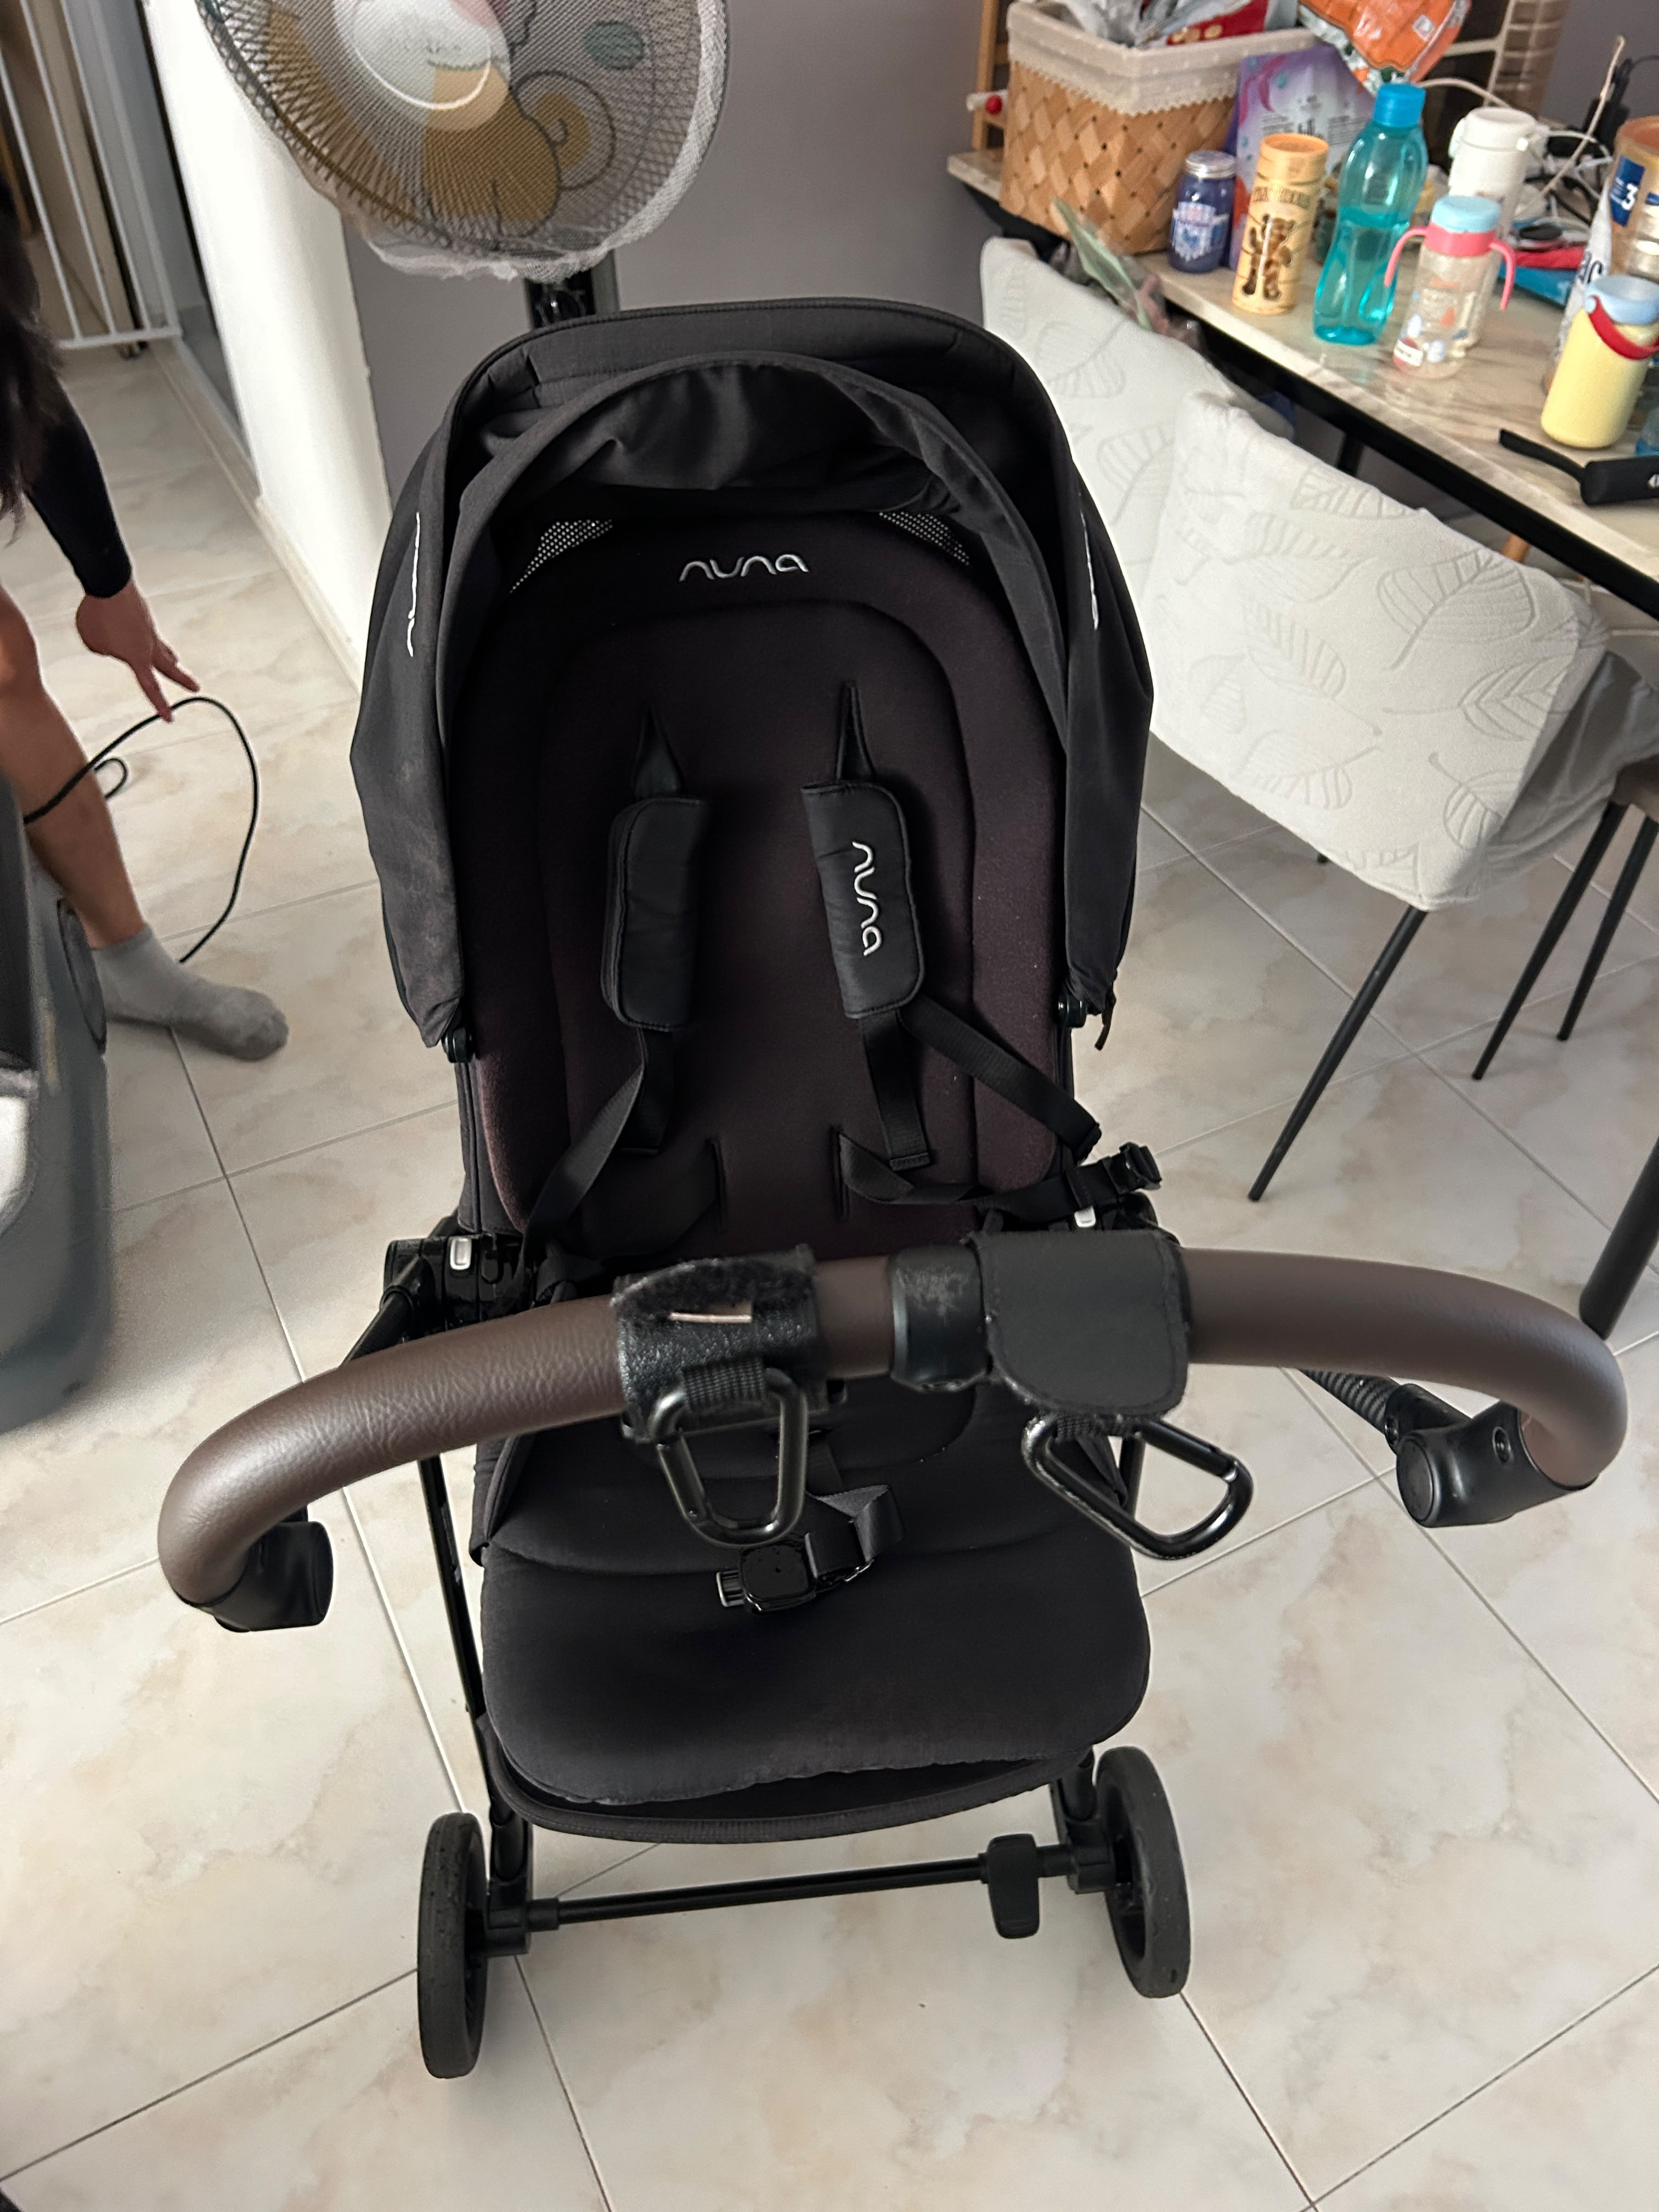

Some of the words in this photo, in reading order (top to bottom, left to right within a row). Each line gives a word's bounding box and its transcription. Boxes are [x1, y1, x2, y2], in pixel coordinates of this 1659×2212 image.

[1621, 183, 1639, 211] 3
[679, 554, 809, 582] nuna
[851, 840, 882, 957] nuna
